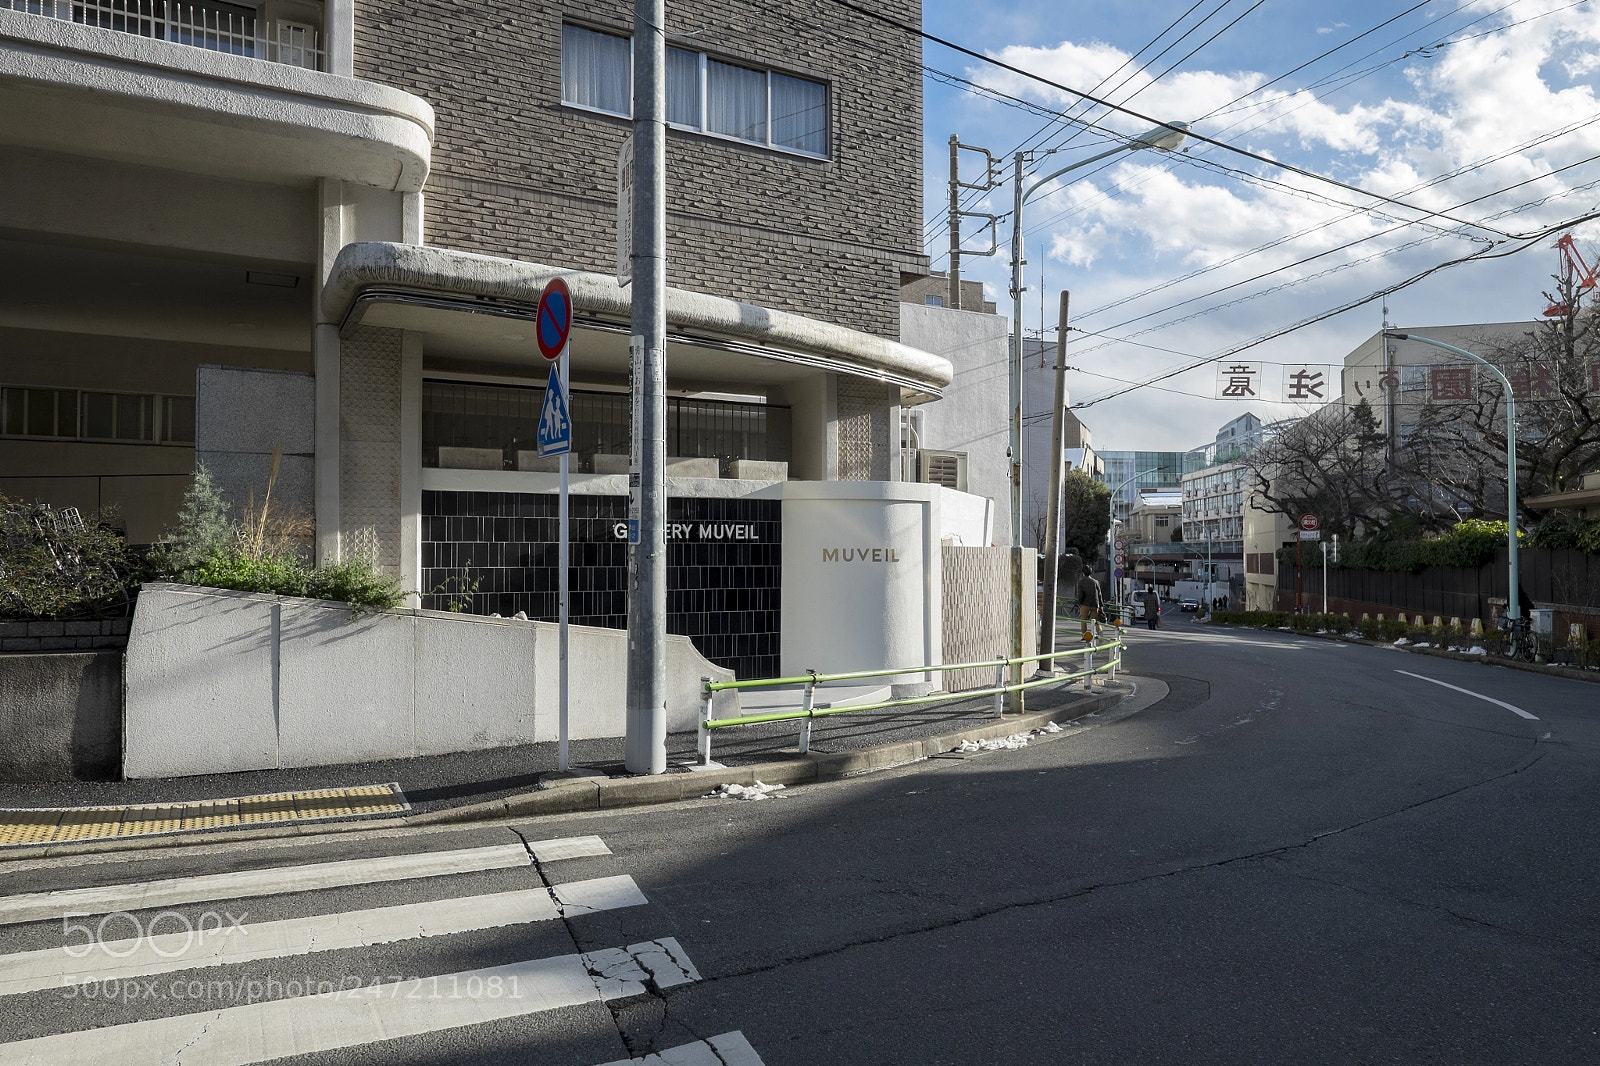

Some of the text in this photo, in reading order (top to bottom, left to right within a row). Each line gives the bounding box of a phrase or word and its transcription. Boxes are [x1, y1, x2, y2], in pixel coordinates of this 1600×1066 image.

[614, 523, 693, 539] GERY
[700, 524, 759, 540] MUVEIL
[822, 548, 900, 563] MUVEIL
